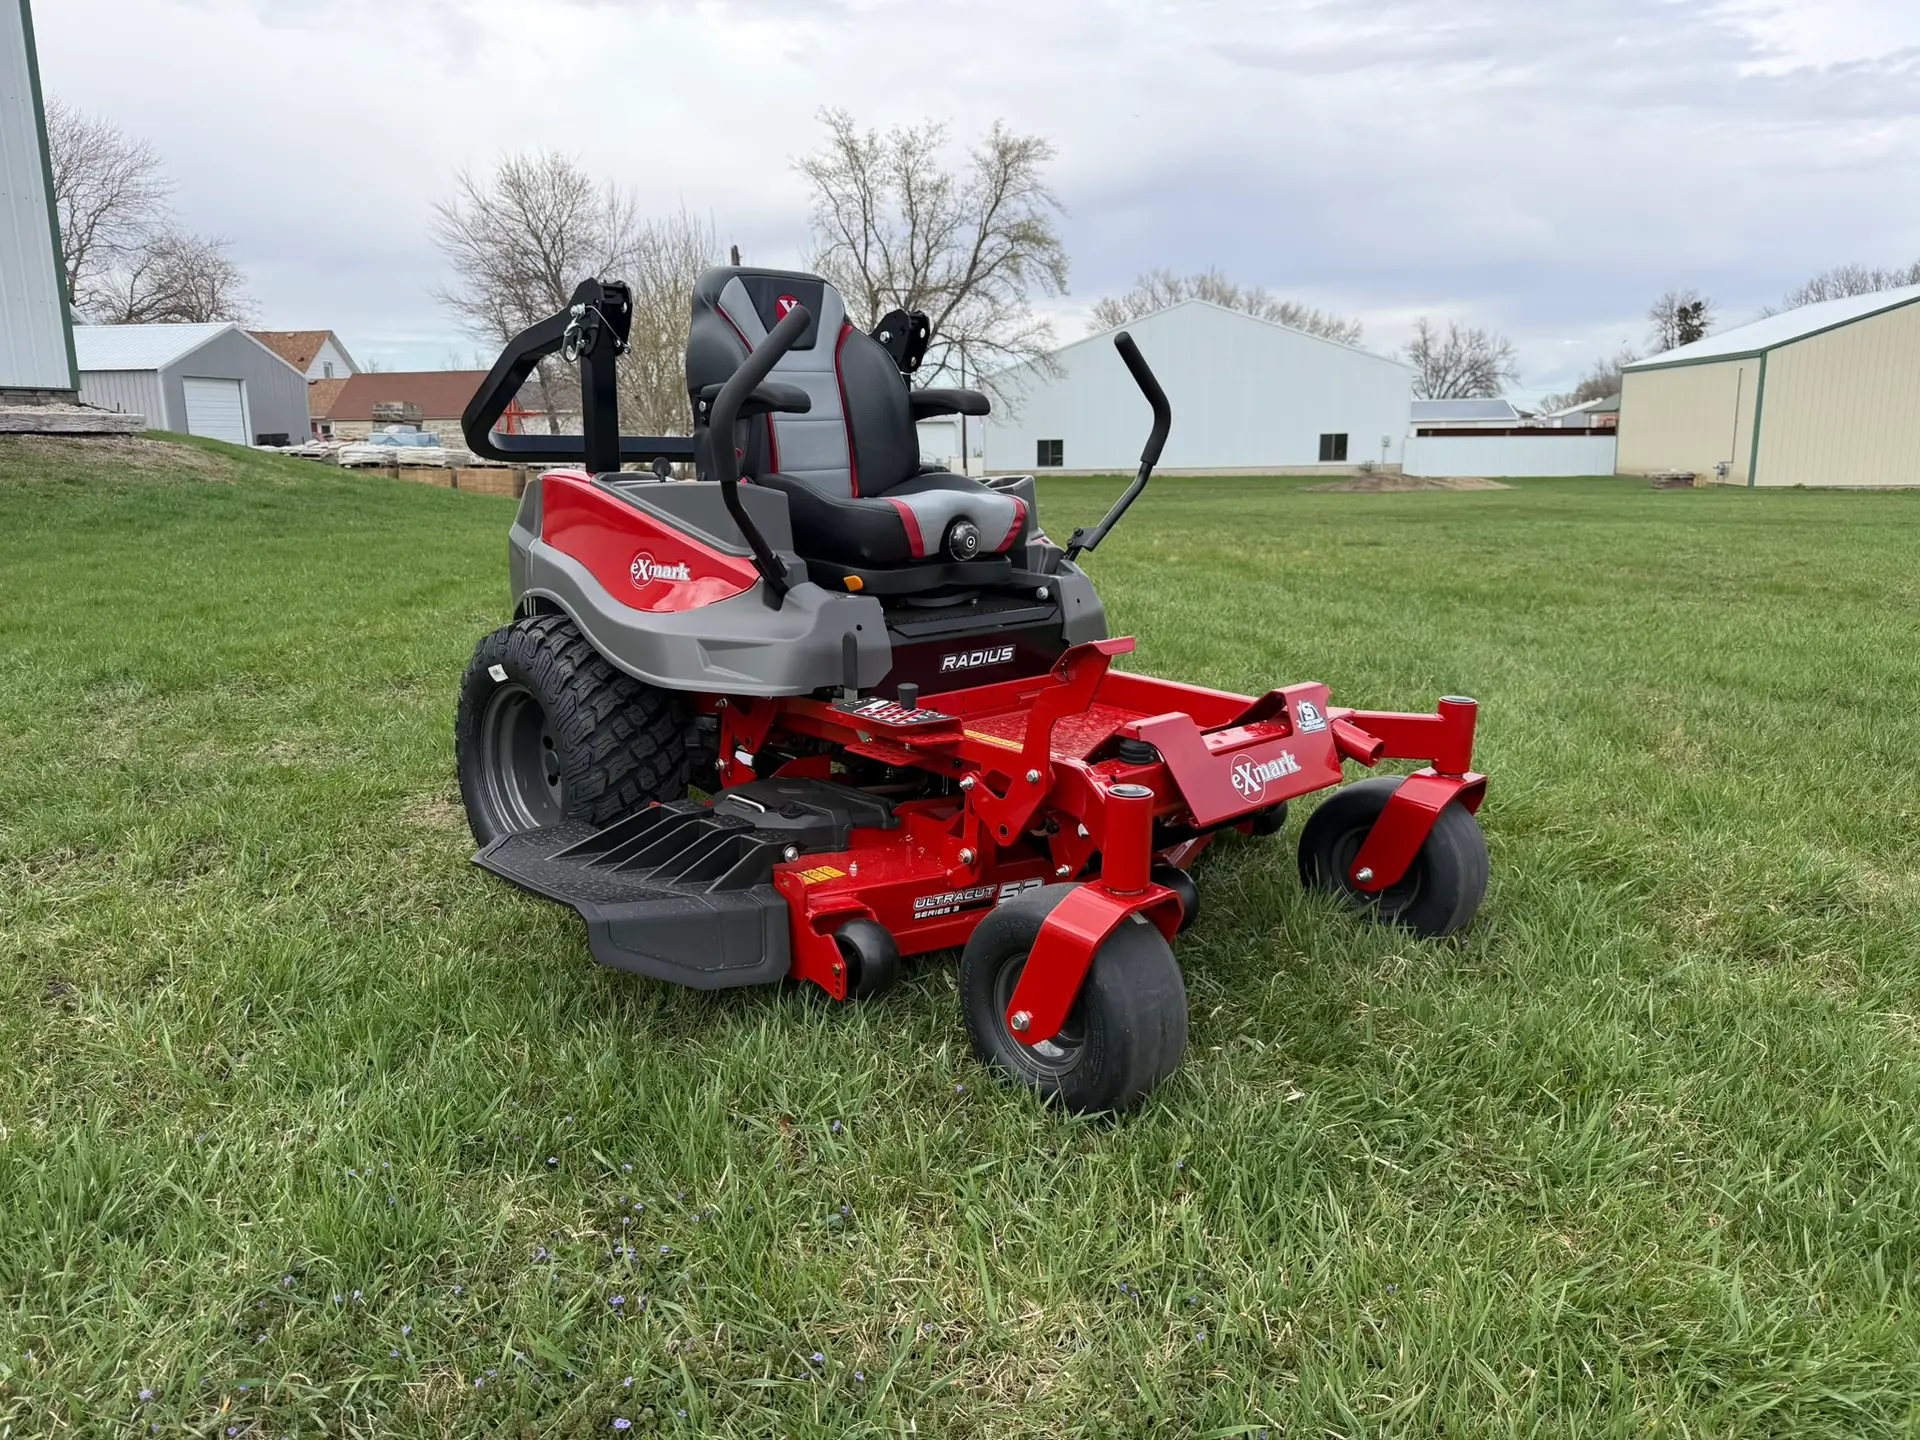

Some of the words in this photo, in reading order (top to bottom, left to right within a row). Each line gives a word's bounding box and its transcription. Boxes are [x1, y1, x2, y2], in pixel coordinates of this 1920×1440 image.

[631, 558, 691, 581] eXmark
[941, 646, 1014, 671] RADIUS
[1231, 749, 1302, 796] eXmark
[914, 886, 996, 909] ULTRACUT
[913, 907, 951, 919] SERIES
[952, 905, 960, 913] 3
